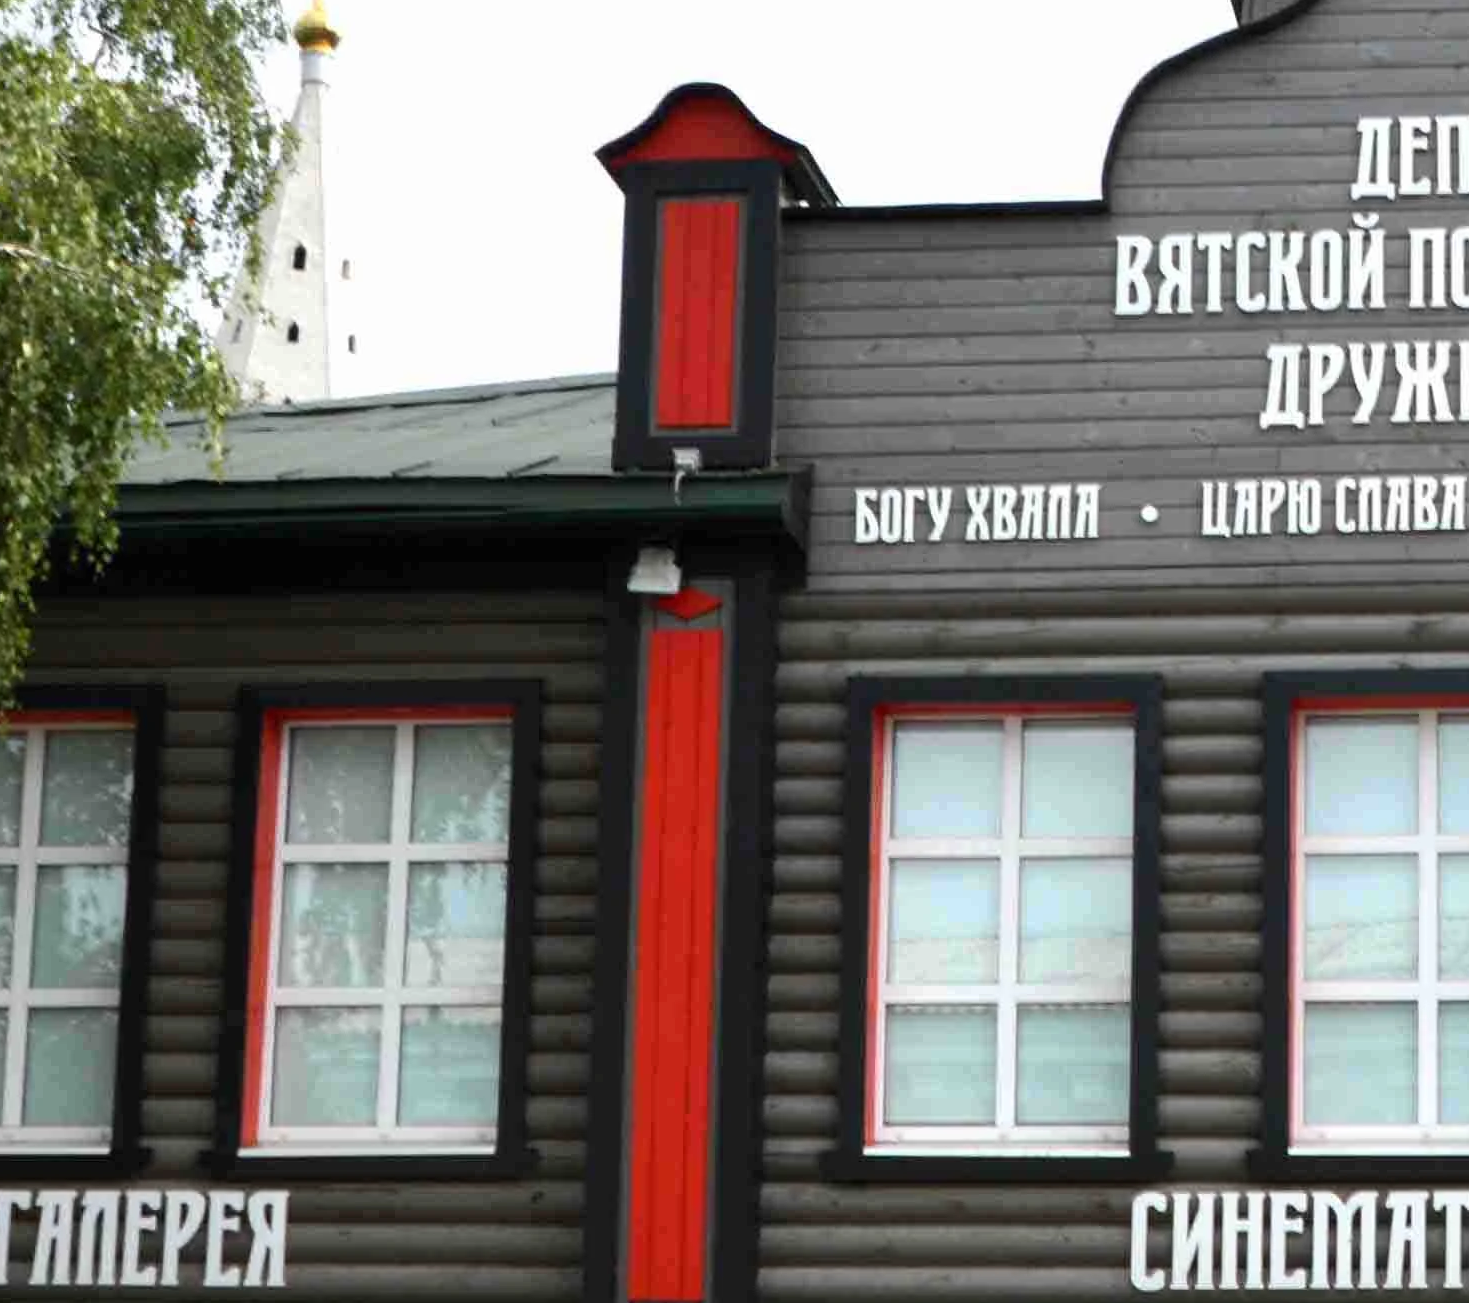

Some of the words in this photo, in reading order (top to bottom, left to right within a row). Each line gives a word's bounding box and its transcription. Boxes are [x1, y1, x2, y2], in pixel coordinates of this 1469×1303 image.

[1114, 212, 1387, 316] ВЯТСКОЙ
[854, 486, 952, 544] БОГУ
[965, 483, 1101, 541] ХВАЛА
[1201, 478, 1322, 539] ЦАРЮ
[1335, 474, 1468, 534] СЛАВА
